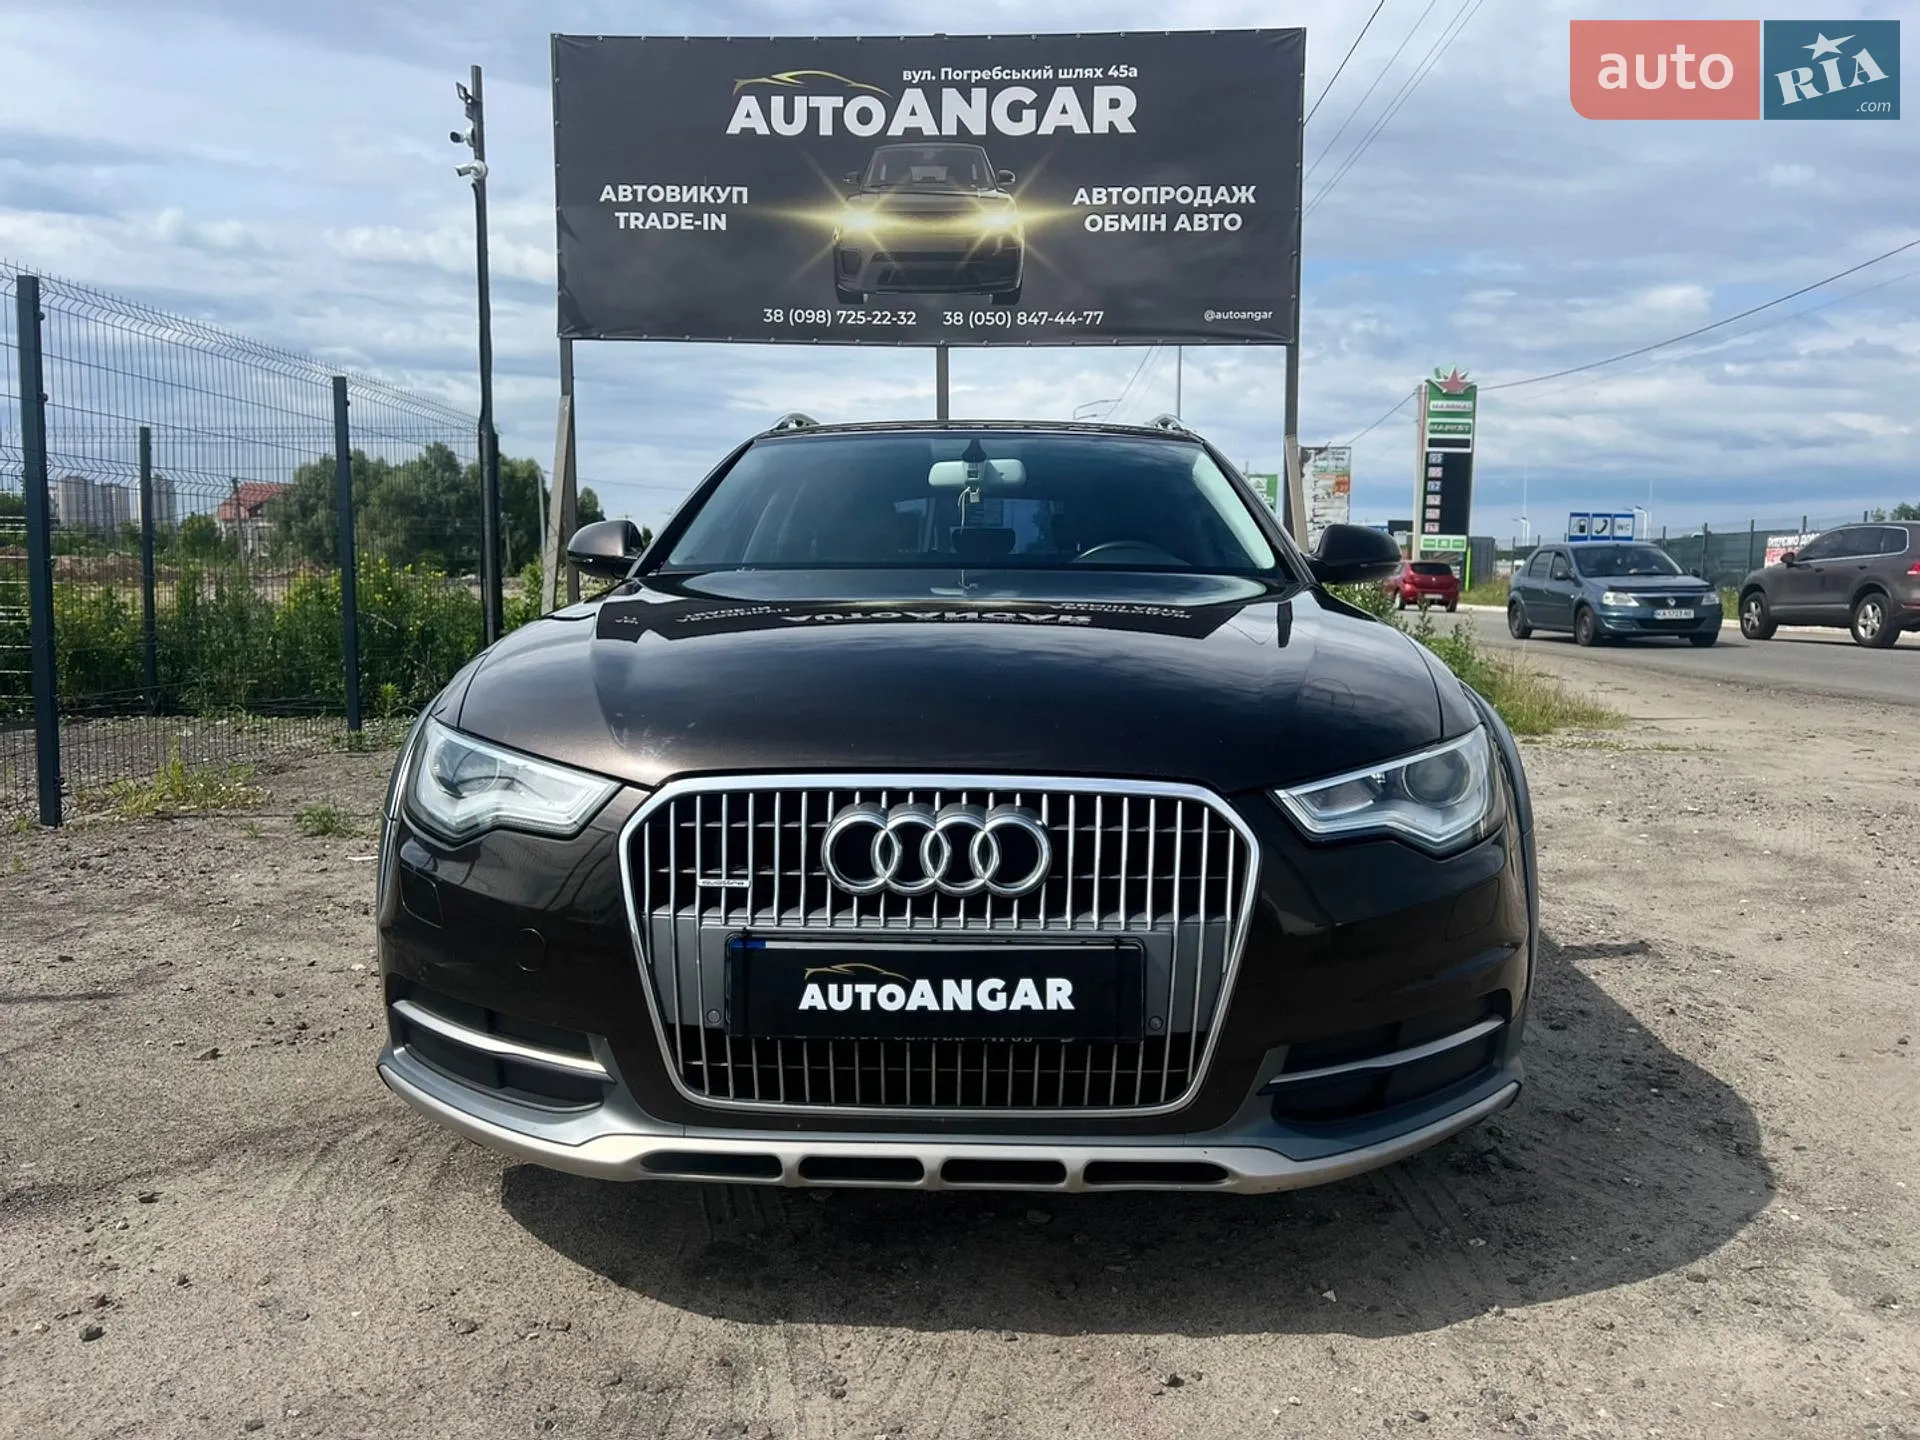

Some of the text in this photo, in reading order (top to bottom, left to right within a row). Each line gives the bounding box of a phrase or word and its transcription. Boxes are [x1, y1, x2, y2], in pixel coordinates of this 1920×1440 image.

[903, 64, 1138, 83] вул. Погребський шлях 45а
[725, 85, 1138, 137] AUTOANGAR
[599, 184, 748, 204] АВТОВИКУП
[1072, 185, 1257, 207] АВТОПРОДАЖ
[614, 212, 727, 230] TRADE-IN
[1084, 213, 1242, 232] ОБМІН АВТО
[763, 308, 917, 326] 38 (098) 725-22-32
[943, 310, 1104, 328] 38 (050) 847-44-77
[1203, 309, 1273, 321] @autoangar
[798, 977, 1075, 1011] AUTOANGAR
